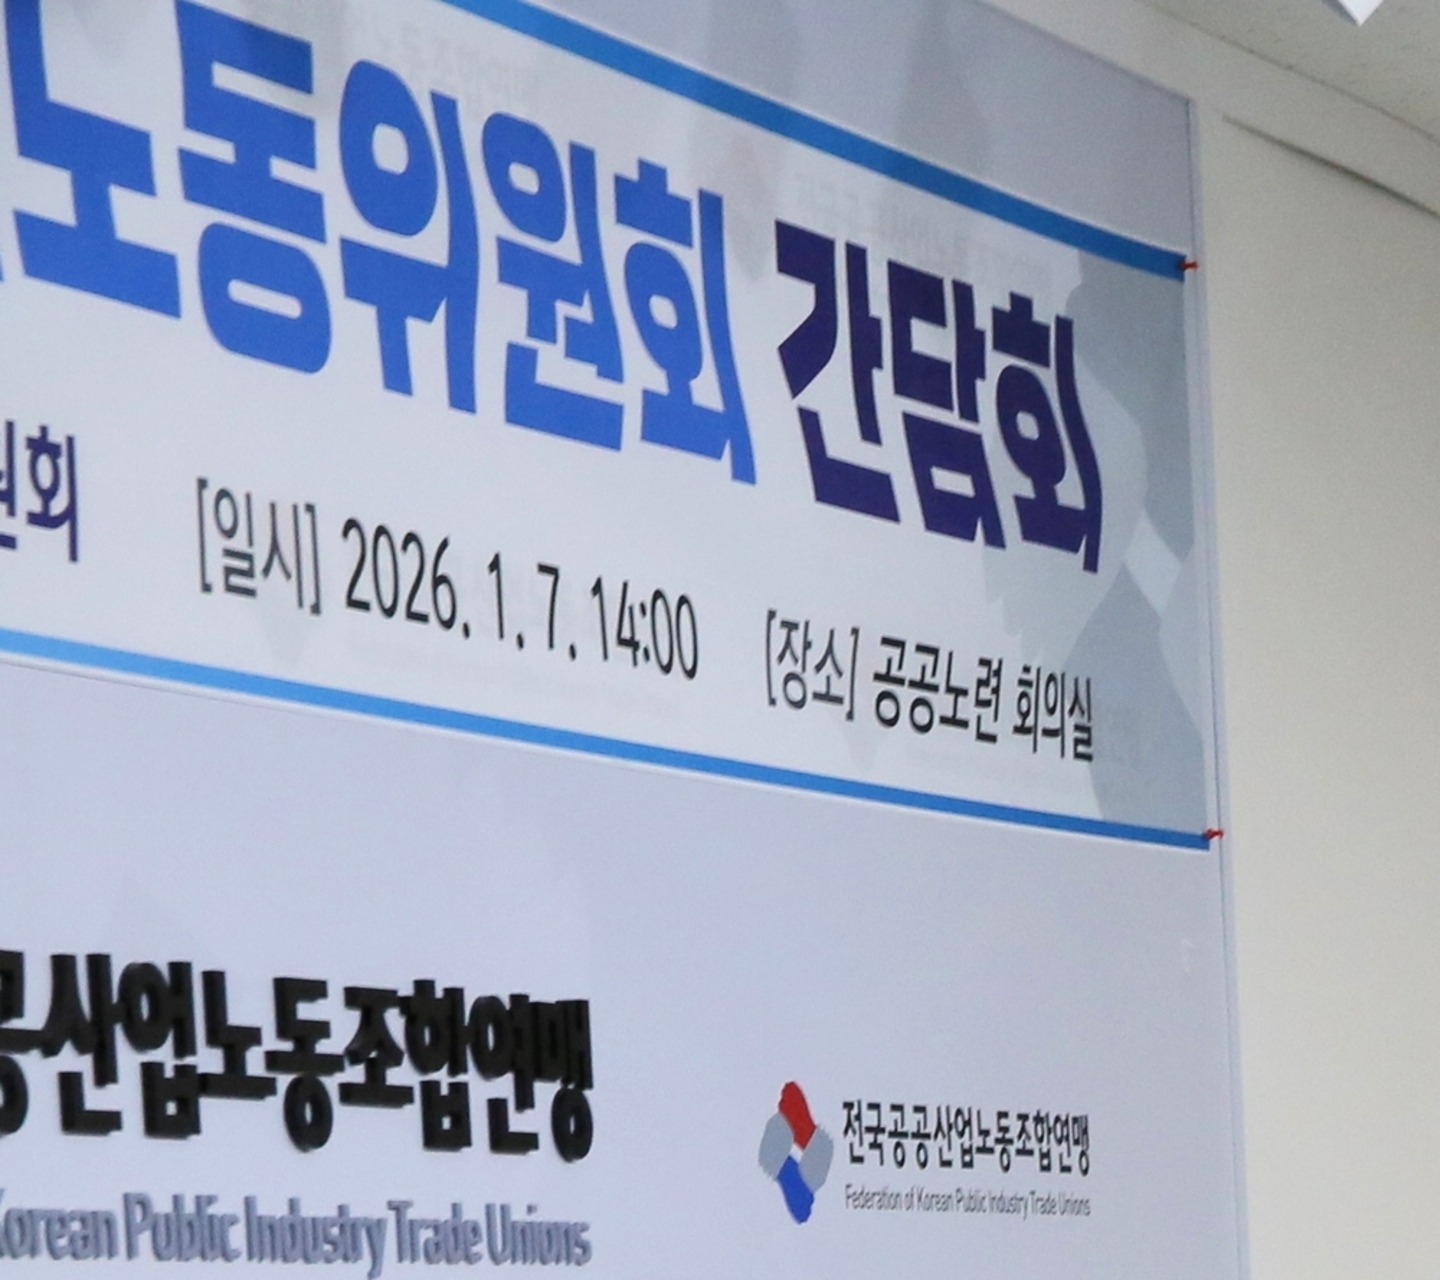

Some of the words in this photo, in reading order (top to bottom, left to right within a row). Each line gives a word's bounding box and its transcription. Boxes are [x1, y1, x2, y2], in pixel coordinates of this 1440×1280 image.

[775, 218, 1103, 574] 간담회
[196, 476, 323, 616] [일시]
[766, 608, 860, 722] [장소]
[873, 635, 1004, 745] 공공노련
[1012, 662, 1096, 763] 회의실
[842, 1099, 1091, 1177] 전국공공산업노동조합연맹
[122, 1191, 242, 1264] Public
[388, 1199, 485, 1266] Trade
[485, 1202, 593, 1267] Unions
[844, 1183, 901, 1211] Federation
[904, 1186, 916, 1211] of
[917, 1187, 953, 1212] Korean
[955, 1187, 988, 1214] Public
[989, 1189, 1029, 1221] Industry
[1029, 1190, 1057, 1215] Trade
[1058, 1191, 1092, 1216] Unions
